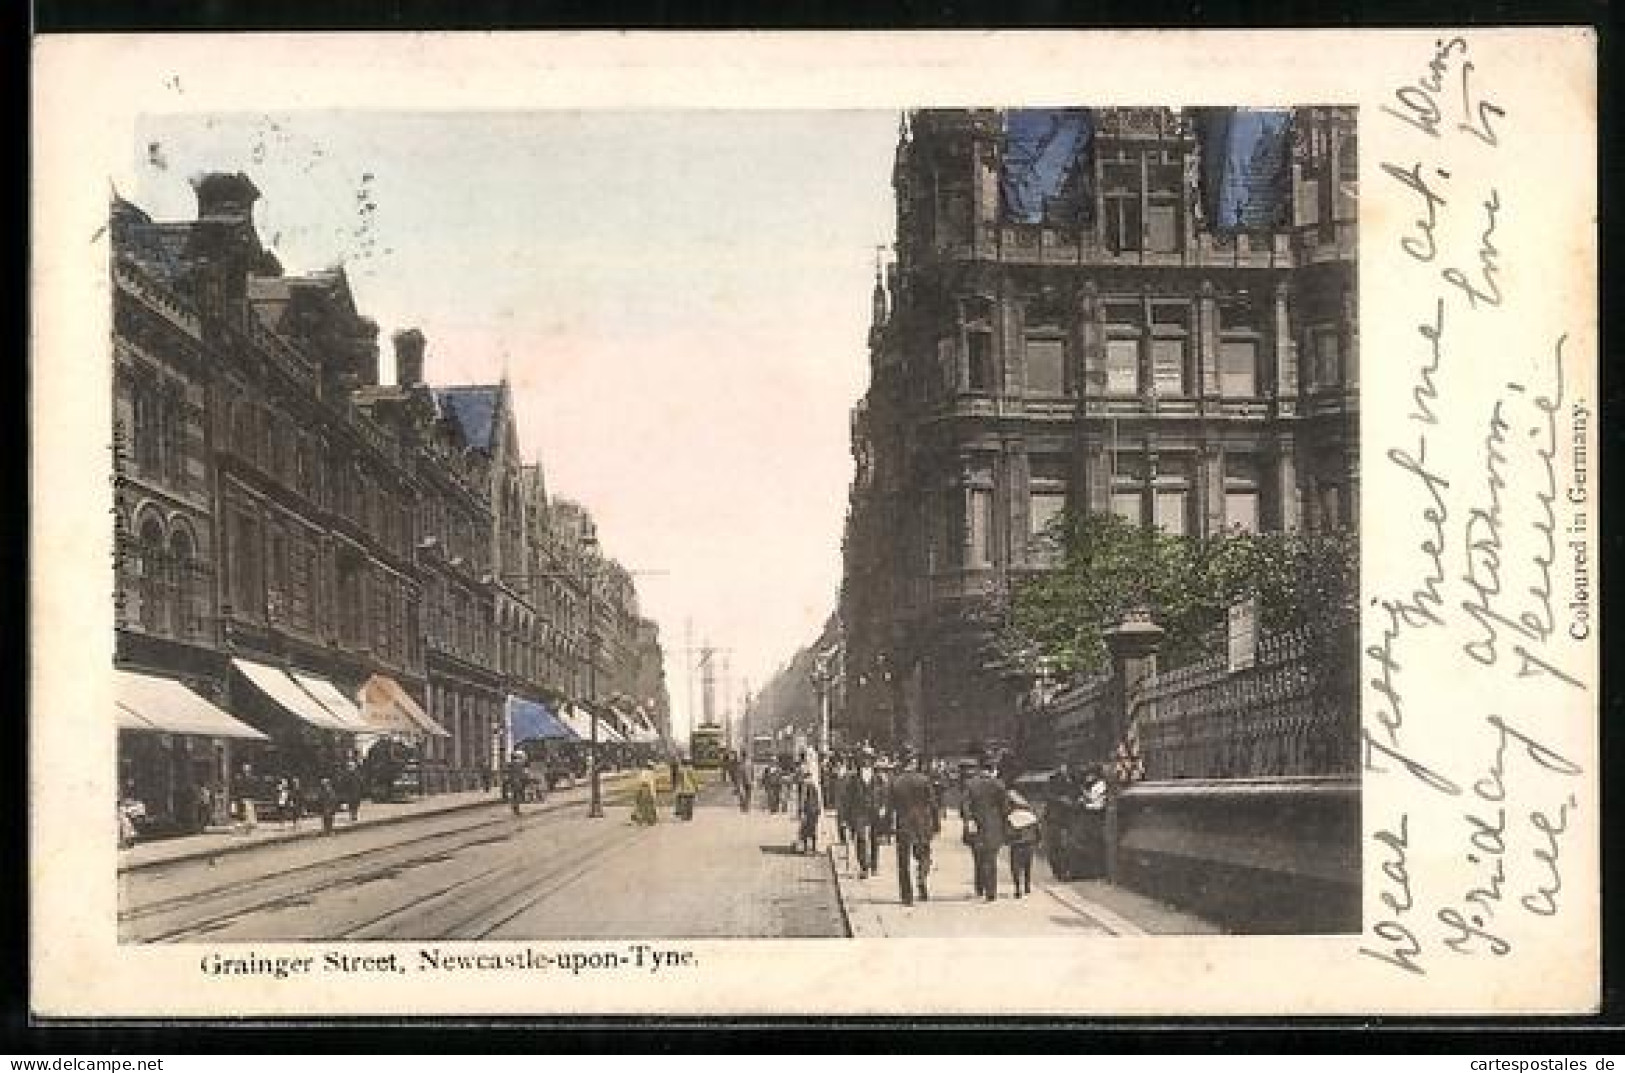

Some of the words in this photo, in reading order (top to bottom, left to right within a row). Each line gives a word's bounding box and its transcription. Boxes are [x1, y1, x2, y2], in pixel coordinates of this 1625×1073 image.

[1566, 398, 1592, 504] Germany.
[1566, 513, 1588, 531] in
[1358, 814, 1426, 975] Dear
[1408, 298, 1444, 424] me
[1568, 540, 1590, 641] Coloured
[200, 951, 313, 978] Grainger
[323, 951, 406, 975] Street,
[418, 944, 700, 975] Newcastle-upon-Tyne.
